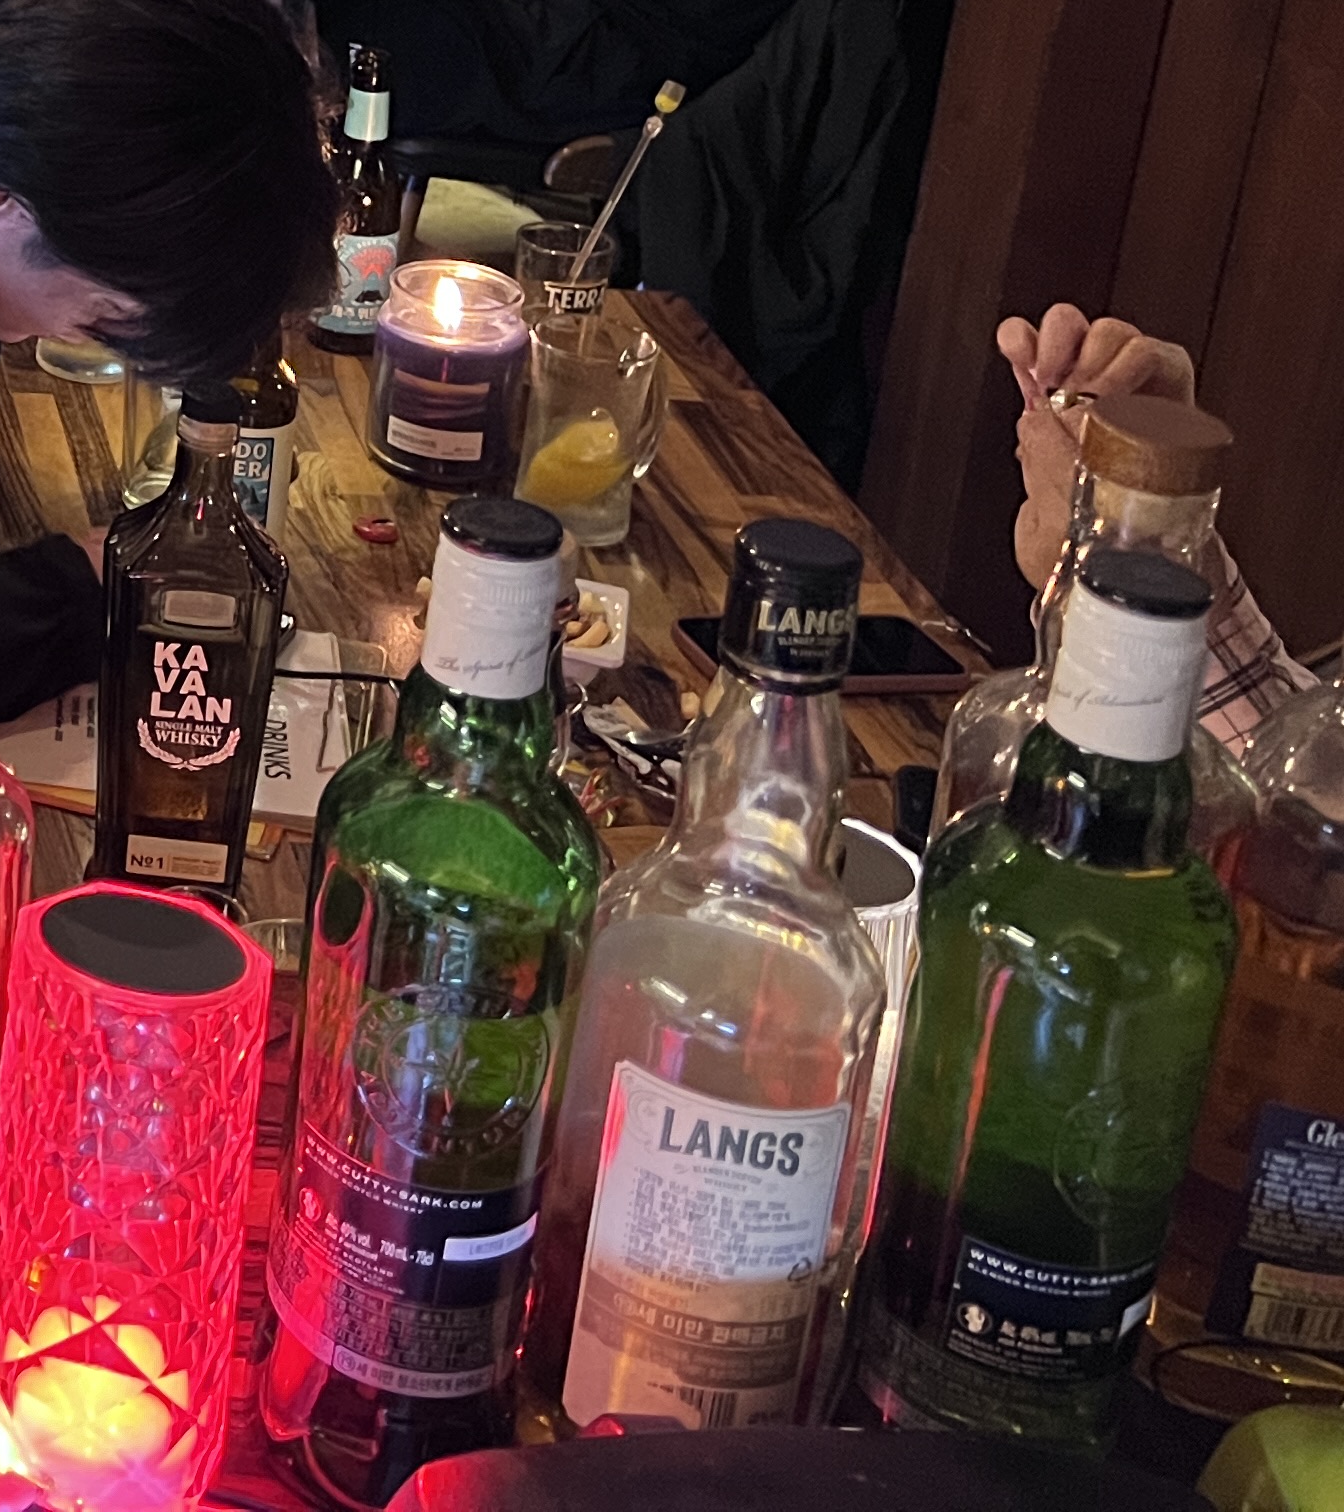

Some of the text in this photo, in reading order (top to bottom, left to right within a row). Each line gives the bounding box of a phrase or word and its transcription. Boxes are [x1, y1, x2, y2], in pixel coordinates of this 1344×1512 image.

[153, 640, 209, 672] KA
[153, 666, 207, 697] VA
[150, 691, 232, 724] LAN
[154, 720, 224, 735] SINGLE MALT
[154, 729, 223, 748] WHISKY
[262, 718, 292, 780] DRINKS
[658, 1105, 805, 1177] LANGS
[306, 1134, 484, 1210] WWW.CUTTY-SARK.COM
[662, 1313, 704, 1341] 미만
